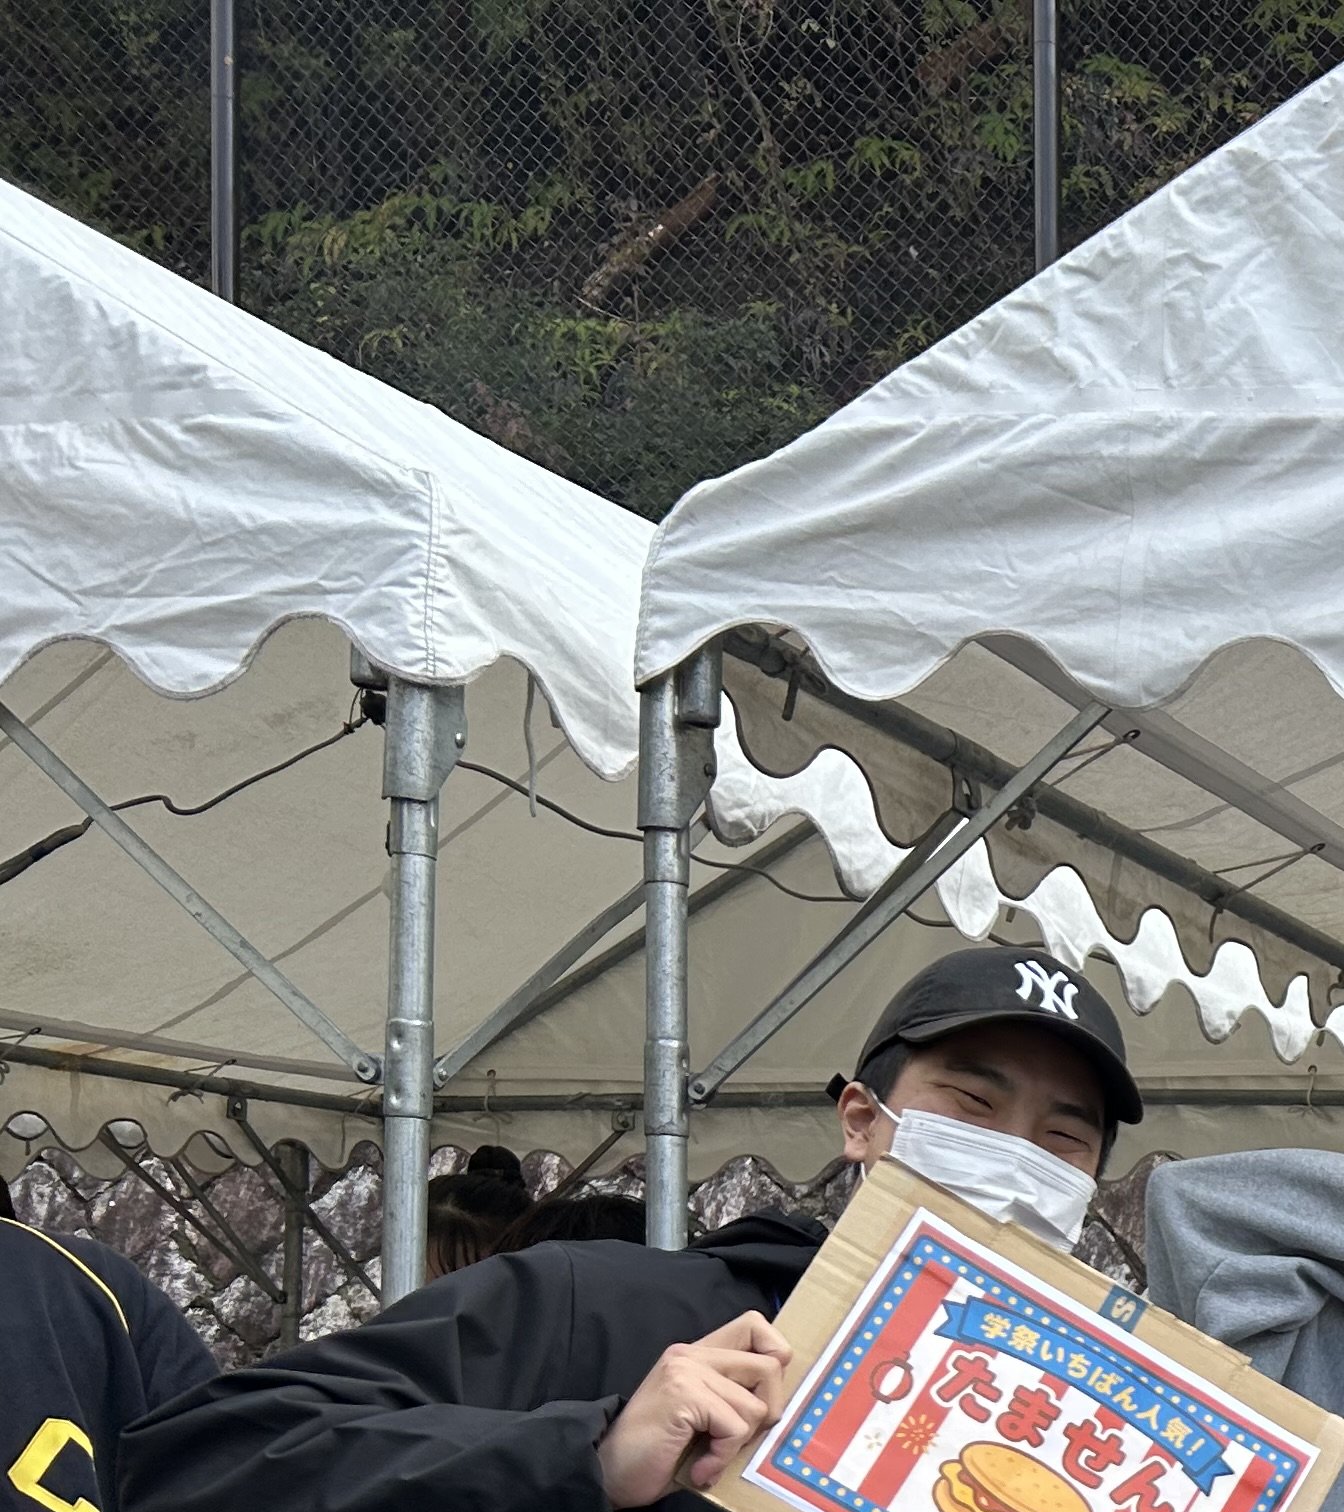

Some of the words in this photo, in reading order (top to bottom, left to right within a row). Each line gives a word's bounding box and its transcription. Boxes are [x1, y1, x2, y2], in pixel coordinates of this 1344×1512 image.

[1014, 960, 1079, 1020] NY
[979, 1312, 1206, 1457] 学祭いちばん人気!
